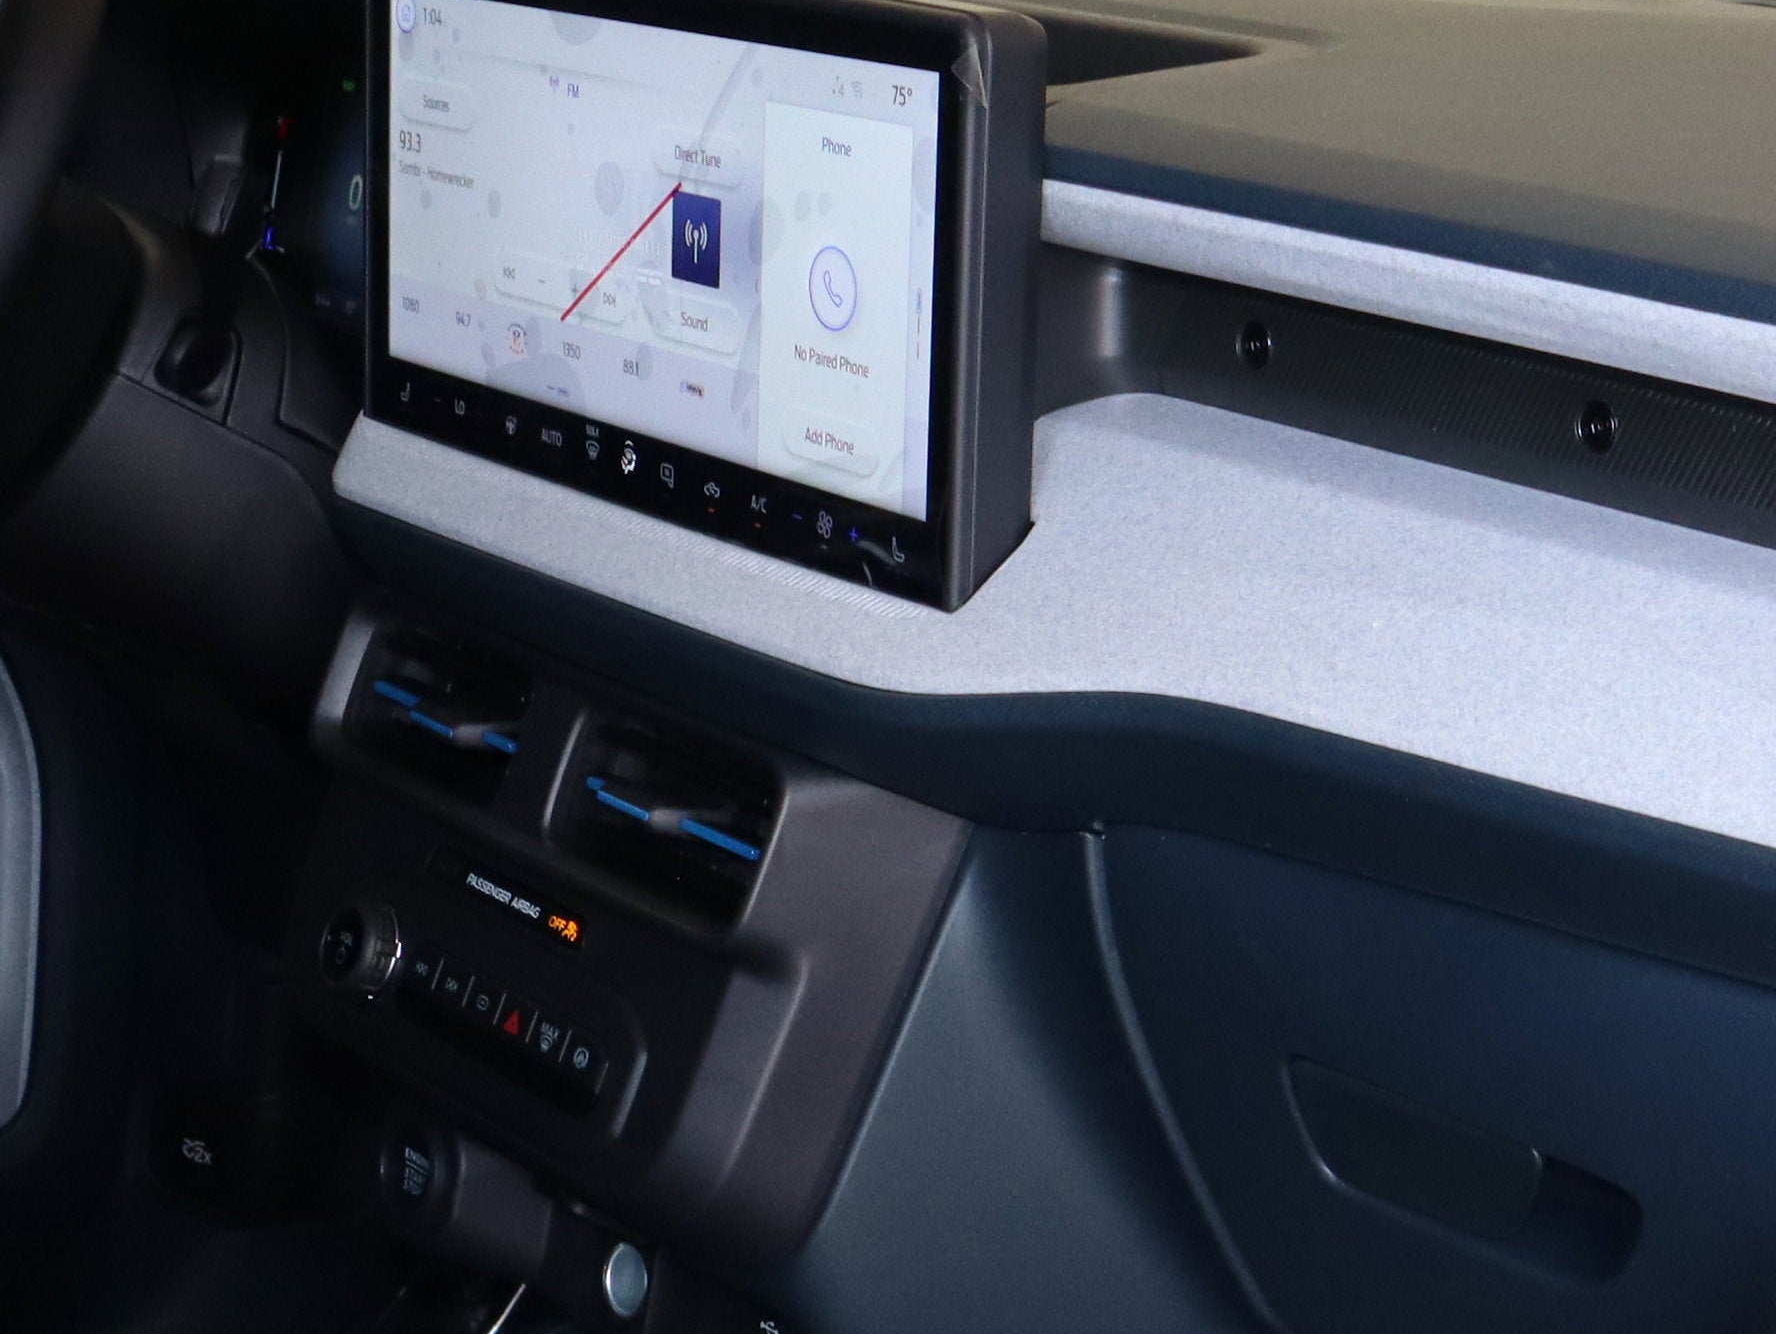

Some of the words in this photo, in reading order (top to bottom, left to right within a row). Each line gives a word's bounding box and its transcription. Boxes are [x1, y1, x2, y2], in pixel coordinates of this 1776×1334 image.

[422, 7, 443, 26] 1:04
[567, 83, 580, 99] FM
[399, 129, 422, 154] 93.3
[822, 136, 852, 157] Phone
[674, 145, 699, 164] Direct
[700, 149, 722, 169] Tune
[681, 311, 708, 332] Sound
[794, 344, 808, 361] No
[808, 349, 838, 370] Paired
[839, 356, 870, 378] Phone
[541, 428, 563, 448] AUTO
[805, 426, 823, 445] Add
[825, 432, 855, 456] Phone
[750, 494, 768, 514] A/C
[465, 871, 512, 906] PASSENGER
[547, 915, 567, 932] OFF
